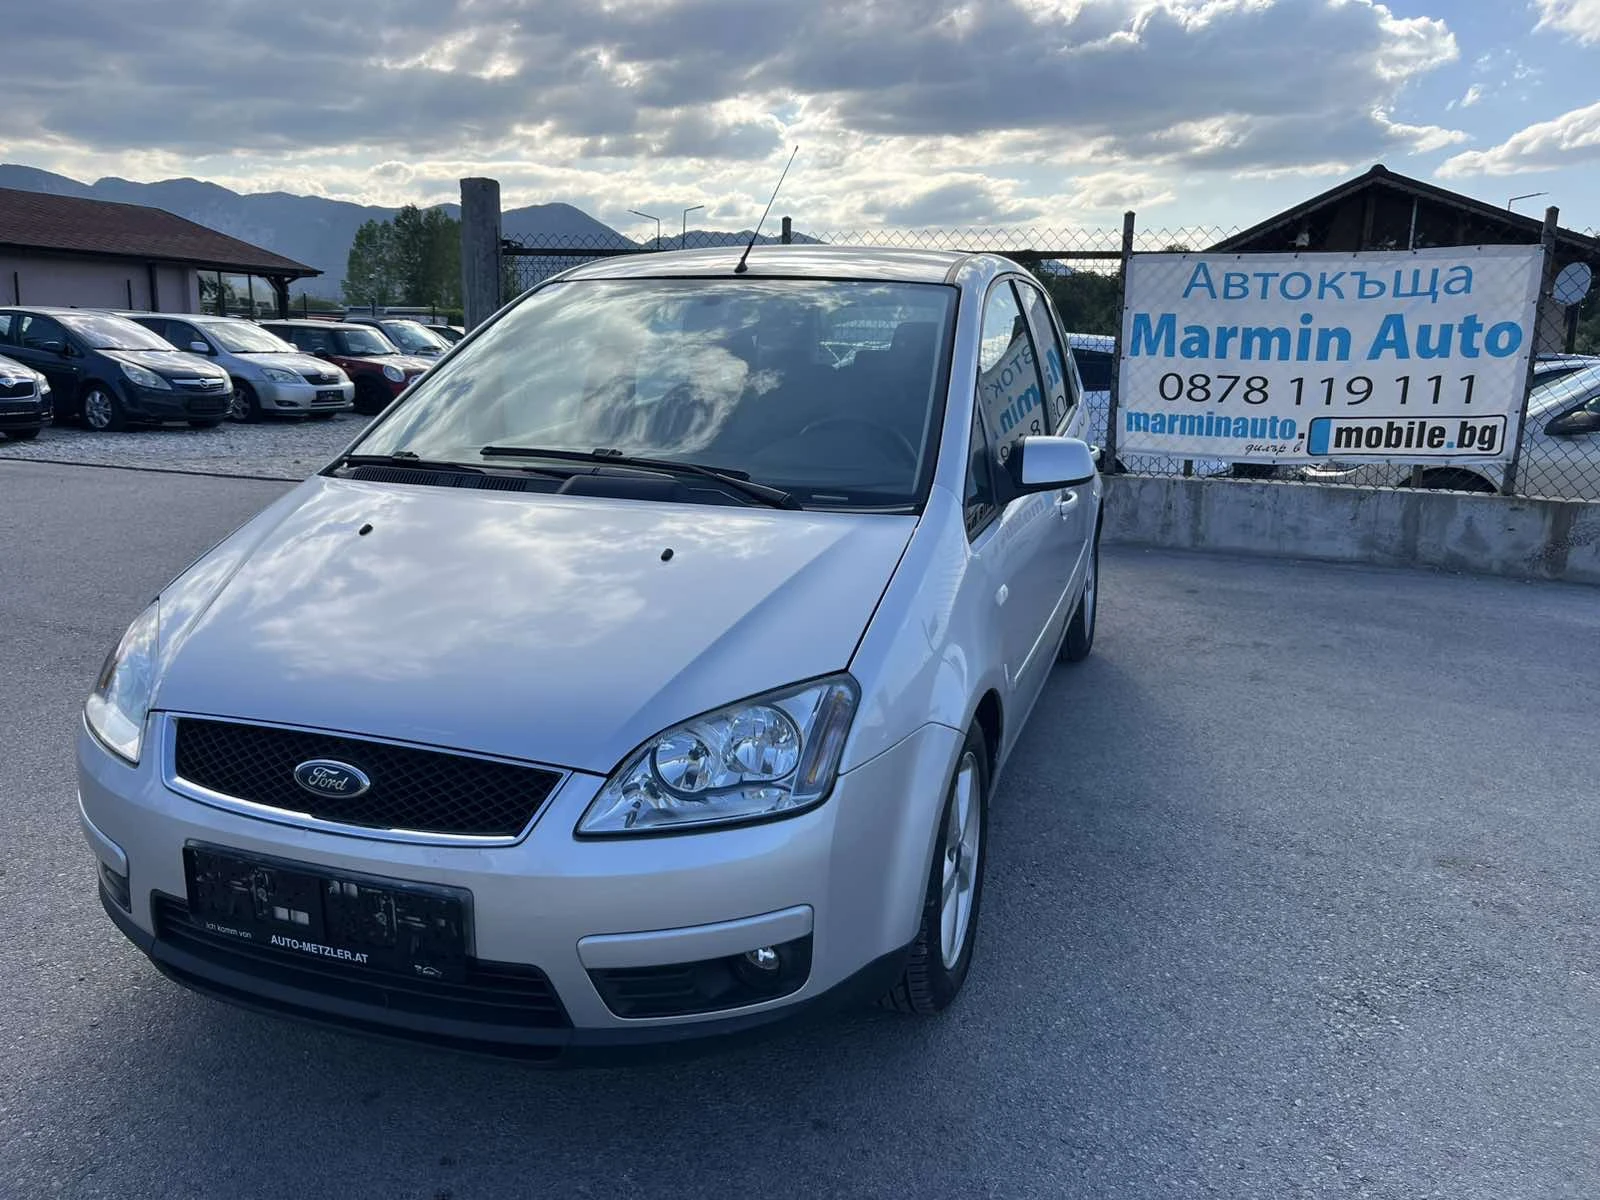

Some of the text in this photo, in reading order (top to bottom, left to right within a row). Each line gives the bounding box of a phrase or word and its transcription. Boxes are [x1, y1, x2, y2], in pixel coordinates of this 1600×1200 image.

[1182, 262, 1473, 303] Автокъща
[1130, 313, 1522, 361] Marmin Auto
[1158, 372, 1476, 406] 0878 119 111
[1334, 421, 1497, 451] mobile.bg
[308, 766, 349, 791] Ford
[217, 923, 238, 936] komm
[271, 935, 368, 963] AUTO-METZLER.AT
